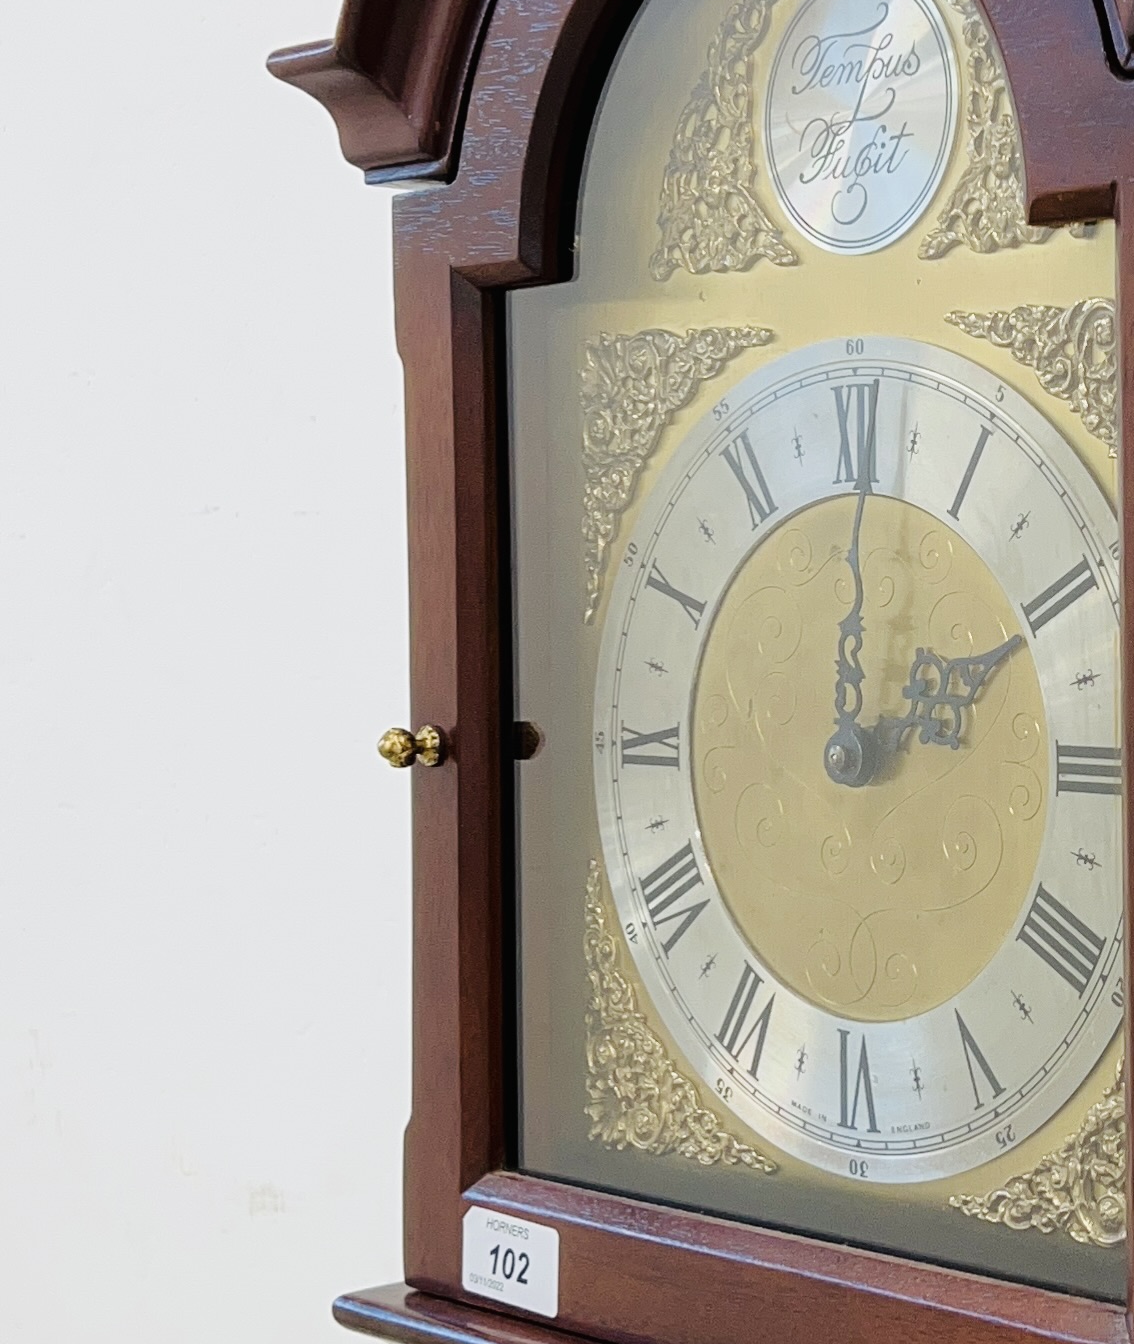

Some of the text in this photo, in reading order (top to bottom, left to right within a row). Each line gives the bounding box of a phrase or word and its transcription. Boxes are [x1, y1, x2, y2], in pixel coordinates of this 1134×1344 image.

[791, 2, 921, 123] Tempus
[799, 111, 914, 225] Fugit
[846, 339, 864, 355] 60
[712, 398, 730, 422] 55
[995, 384, 1007, 403] 5
[831, 380, 880, 485] XII
[719, 427, 779, 532] XI
[947, 424, 994, 521] I
[623, 542, 639, 568] 50
[644, 557, 708, 631] X
[1020, 553, 1100, 638] II
[595, 731, 605, 754] 45
[620, 719, 680, 771] IX
[1056, 739, 1122, 797] III
[638, 838, 711, 958] VIII
[625, 922, 639, 946] 40
[1016, 881, 1107, 999] IIII
[714, 959, 776, 1082] VII
[837, 1028, 881, 1134] VI
[954, 1007, 1006, 1111] V
[715, 1076, 734, 1104] 35
[891, 1121, 931, 1134] ENGLAND
[995, 1123, 1016, 1148] 25
[850, 1158, 869, 1178] 30
[486, 1218, 529, 1240] HORNERS
[490, 1244, 530, 1285] 102
